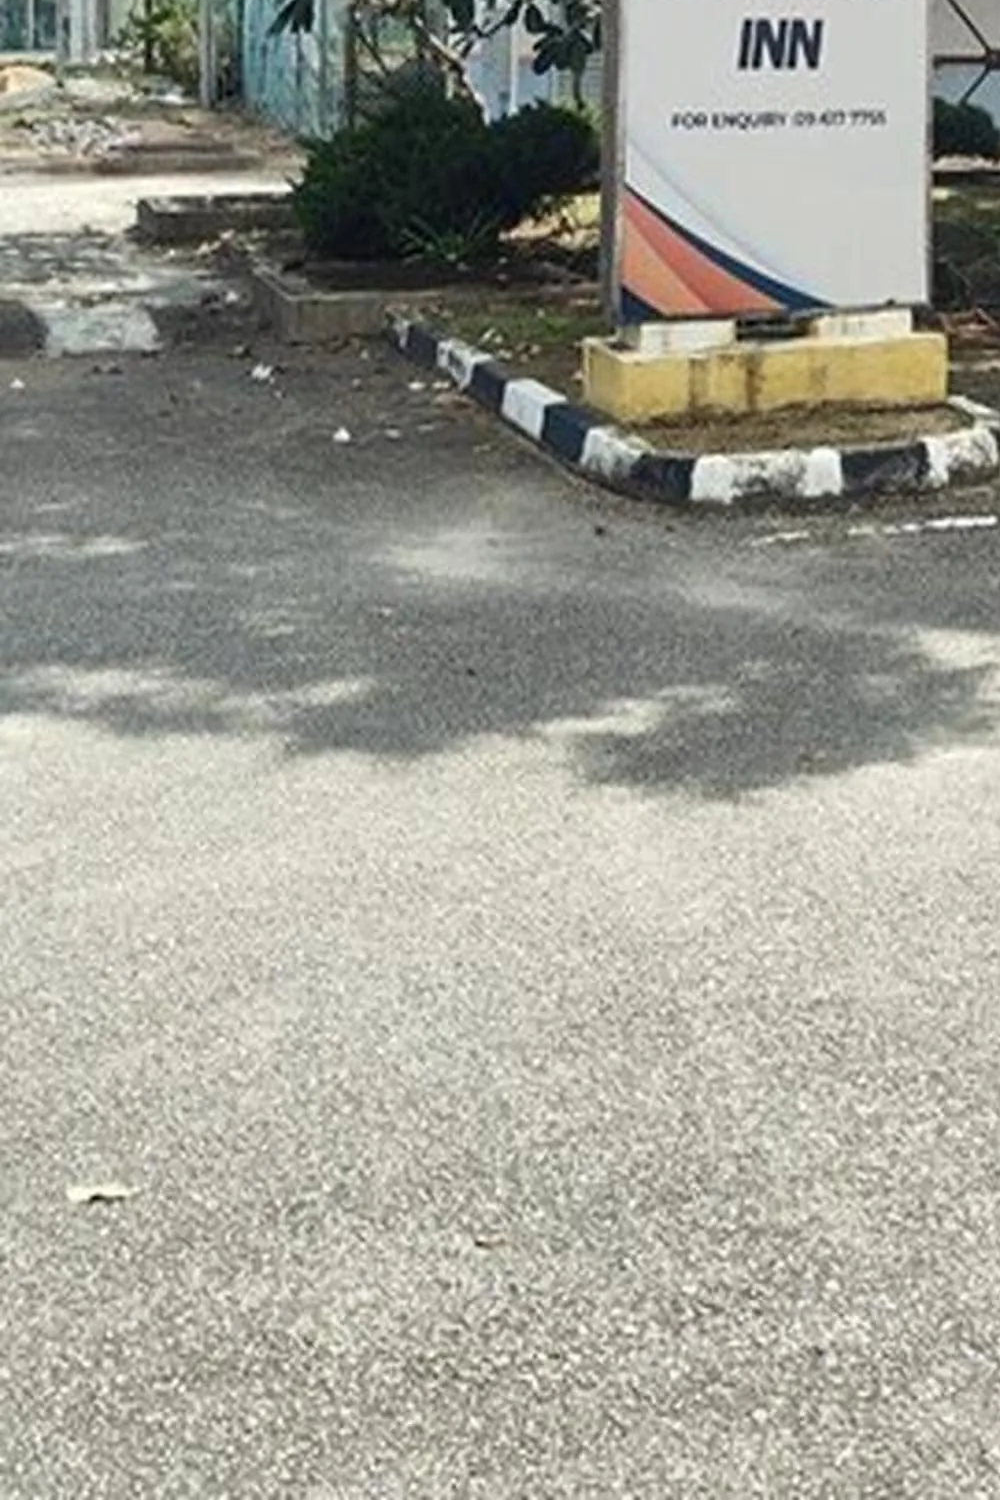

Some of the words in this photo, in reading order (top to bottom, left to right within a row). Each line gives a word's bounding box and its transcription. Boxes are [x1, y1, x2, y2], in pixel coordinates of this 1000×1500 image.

[737, 18, 824, 70] INN
[671, 112, 708, 130] FOR
[711, 111, 787, 131] ENQUIRY
